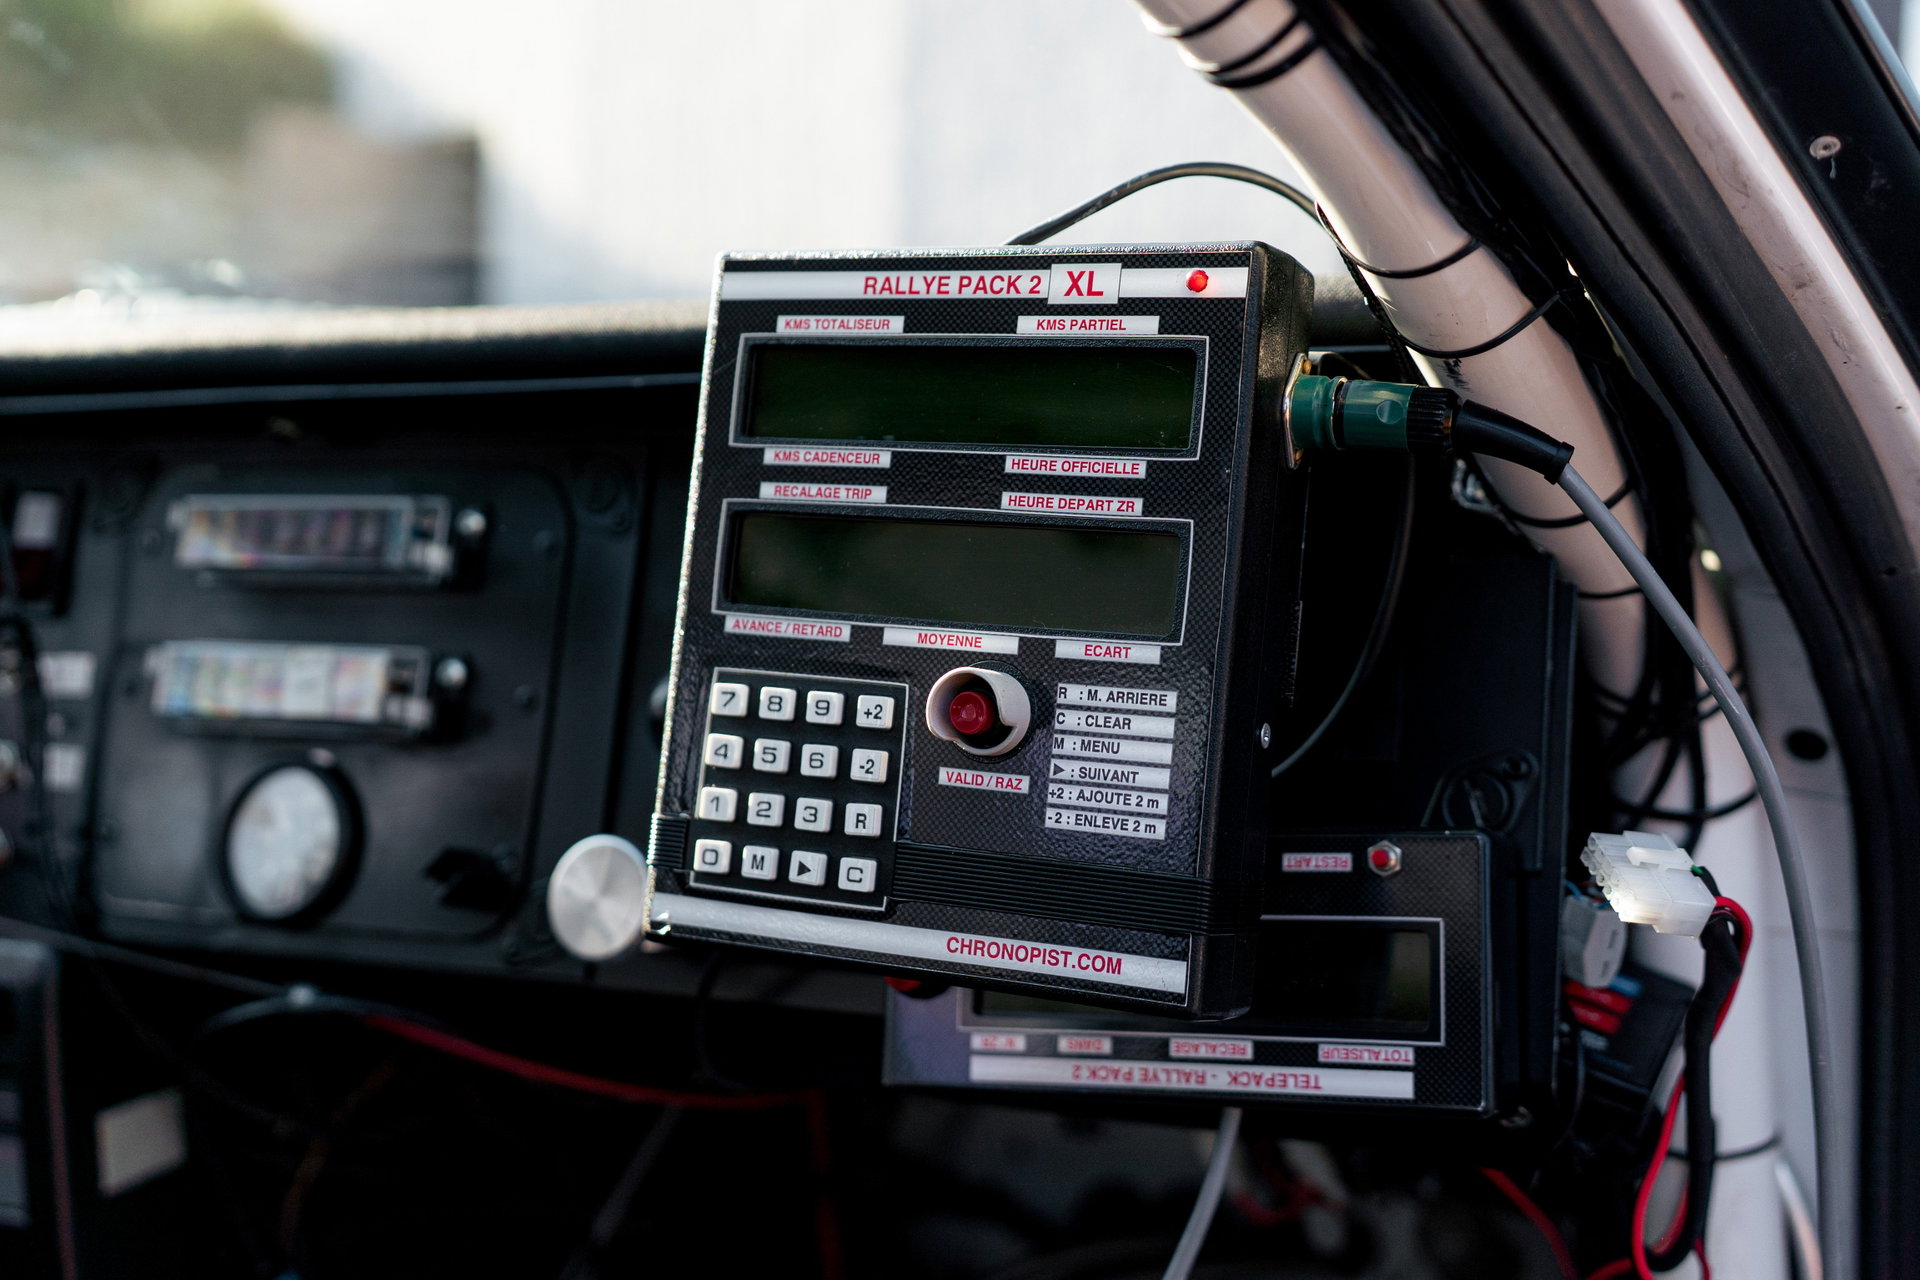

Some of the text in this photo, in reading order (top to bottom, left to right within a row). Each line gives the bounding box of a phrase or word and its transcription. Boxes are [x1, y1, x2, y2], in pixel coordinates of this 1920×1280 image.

[864, 270, 1104, 297] RALLYE PACK 2 XL
[785, 319, 890, 330] KMS TOTALISEUR
[1037, 319, 1127, 331] KMS PARTIEL
[774, 451, 881, 465] KMS CADENCEUR
[1011, 458, 1140, 475] HEURE OFFICIELLE
[774, 485, 873, 500] RECALAGE TRIP
[1008, 495, 1136, 513] HEURE DEPART ZR
[732, 619, 781, 633] AVANCE
[792, 624, 843, 638] RETARD
[918, 633, 982, 648] MOYENNE
[1084, 644, 1131, 659] ECART
[721, 691, 736, 708] 7
[767, 695, 782, 712] 8
[1058, 687, 1067, 699] R
[1106, 691, 1168, 707] ARRIERE
[815, 700, 830, 716] 9
[863, 704, 884, 720] +2
[1056, 713, 1066, 725] C
[1085, 715, 1132, 730] CLEAR
[714, 743, 729, 760] 4
[1053, 737, 1065, 750] M
[1080, 740, 1121, 754] MENU
[762, 747, 778, 764] 5
[809, 752, 824, 769] 6
[859, 759, 875, 775] -2
[1078, 767, 1139, 784] SUIVANT
[945, 770, 984, 787] VALID
[995, 776, 1023, 791] RAZ
[710, 796, 720, 813] 1
[1048, 787, 1064, 800] +2
[1076, 791, 1132, 807] AJOUTE
[1135, 797, 1144, 808] 2
[1147, 798, 1159, 809] m
[756, 801, 772, 818] 2
[802, 806, 818, 823] 3
[855, 813, 868, 830] R
[1074, 814, 1129, 831] ENLEVE
[1133, 822, 1141, 833] 2
[1145, 823, 1157, 834] m
[751, 854, 765, 871] M
[1285, 856, 1349, 870] RESTART
[846, 866, 864, 884] C
[946, 936, 1123, 975] CHRONOPIST.COM
[1173, 1041, 1247, 1056] RECALAGE
[1320, 1046, 1410, 1062] TOTALISEUR
[1072, 1064, 1081, 1079] 2
[1087, 1065, 1133, 1081] PACK
[1139, 1067, 1206, 1085] RALLYE
[1228, 1071, 1323, 1090] TELEPACK
